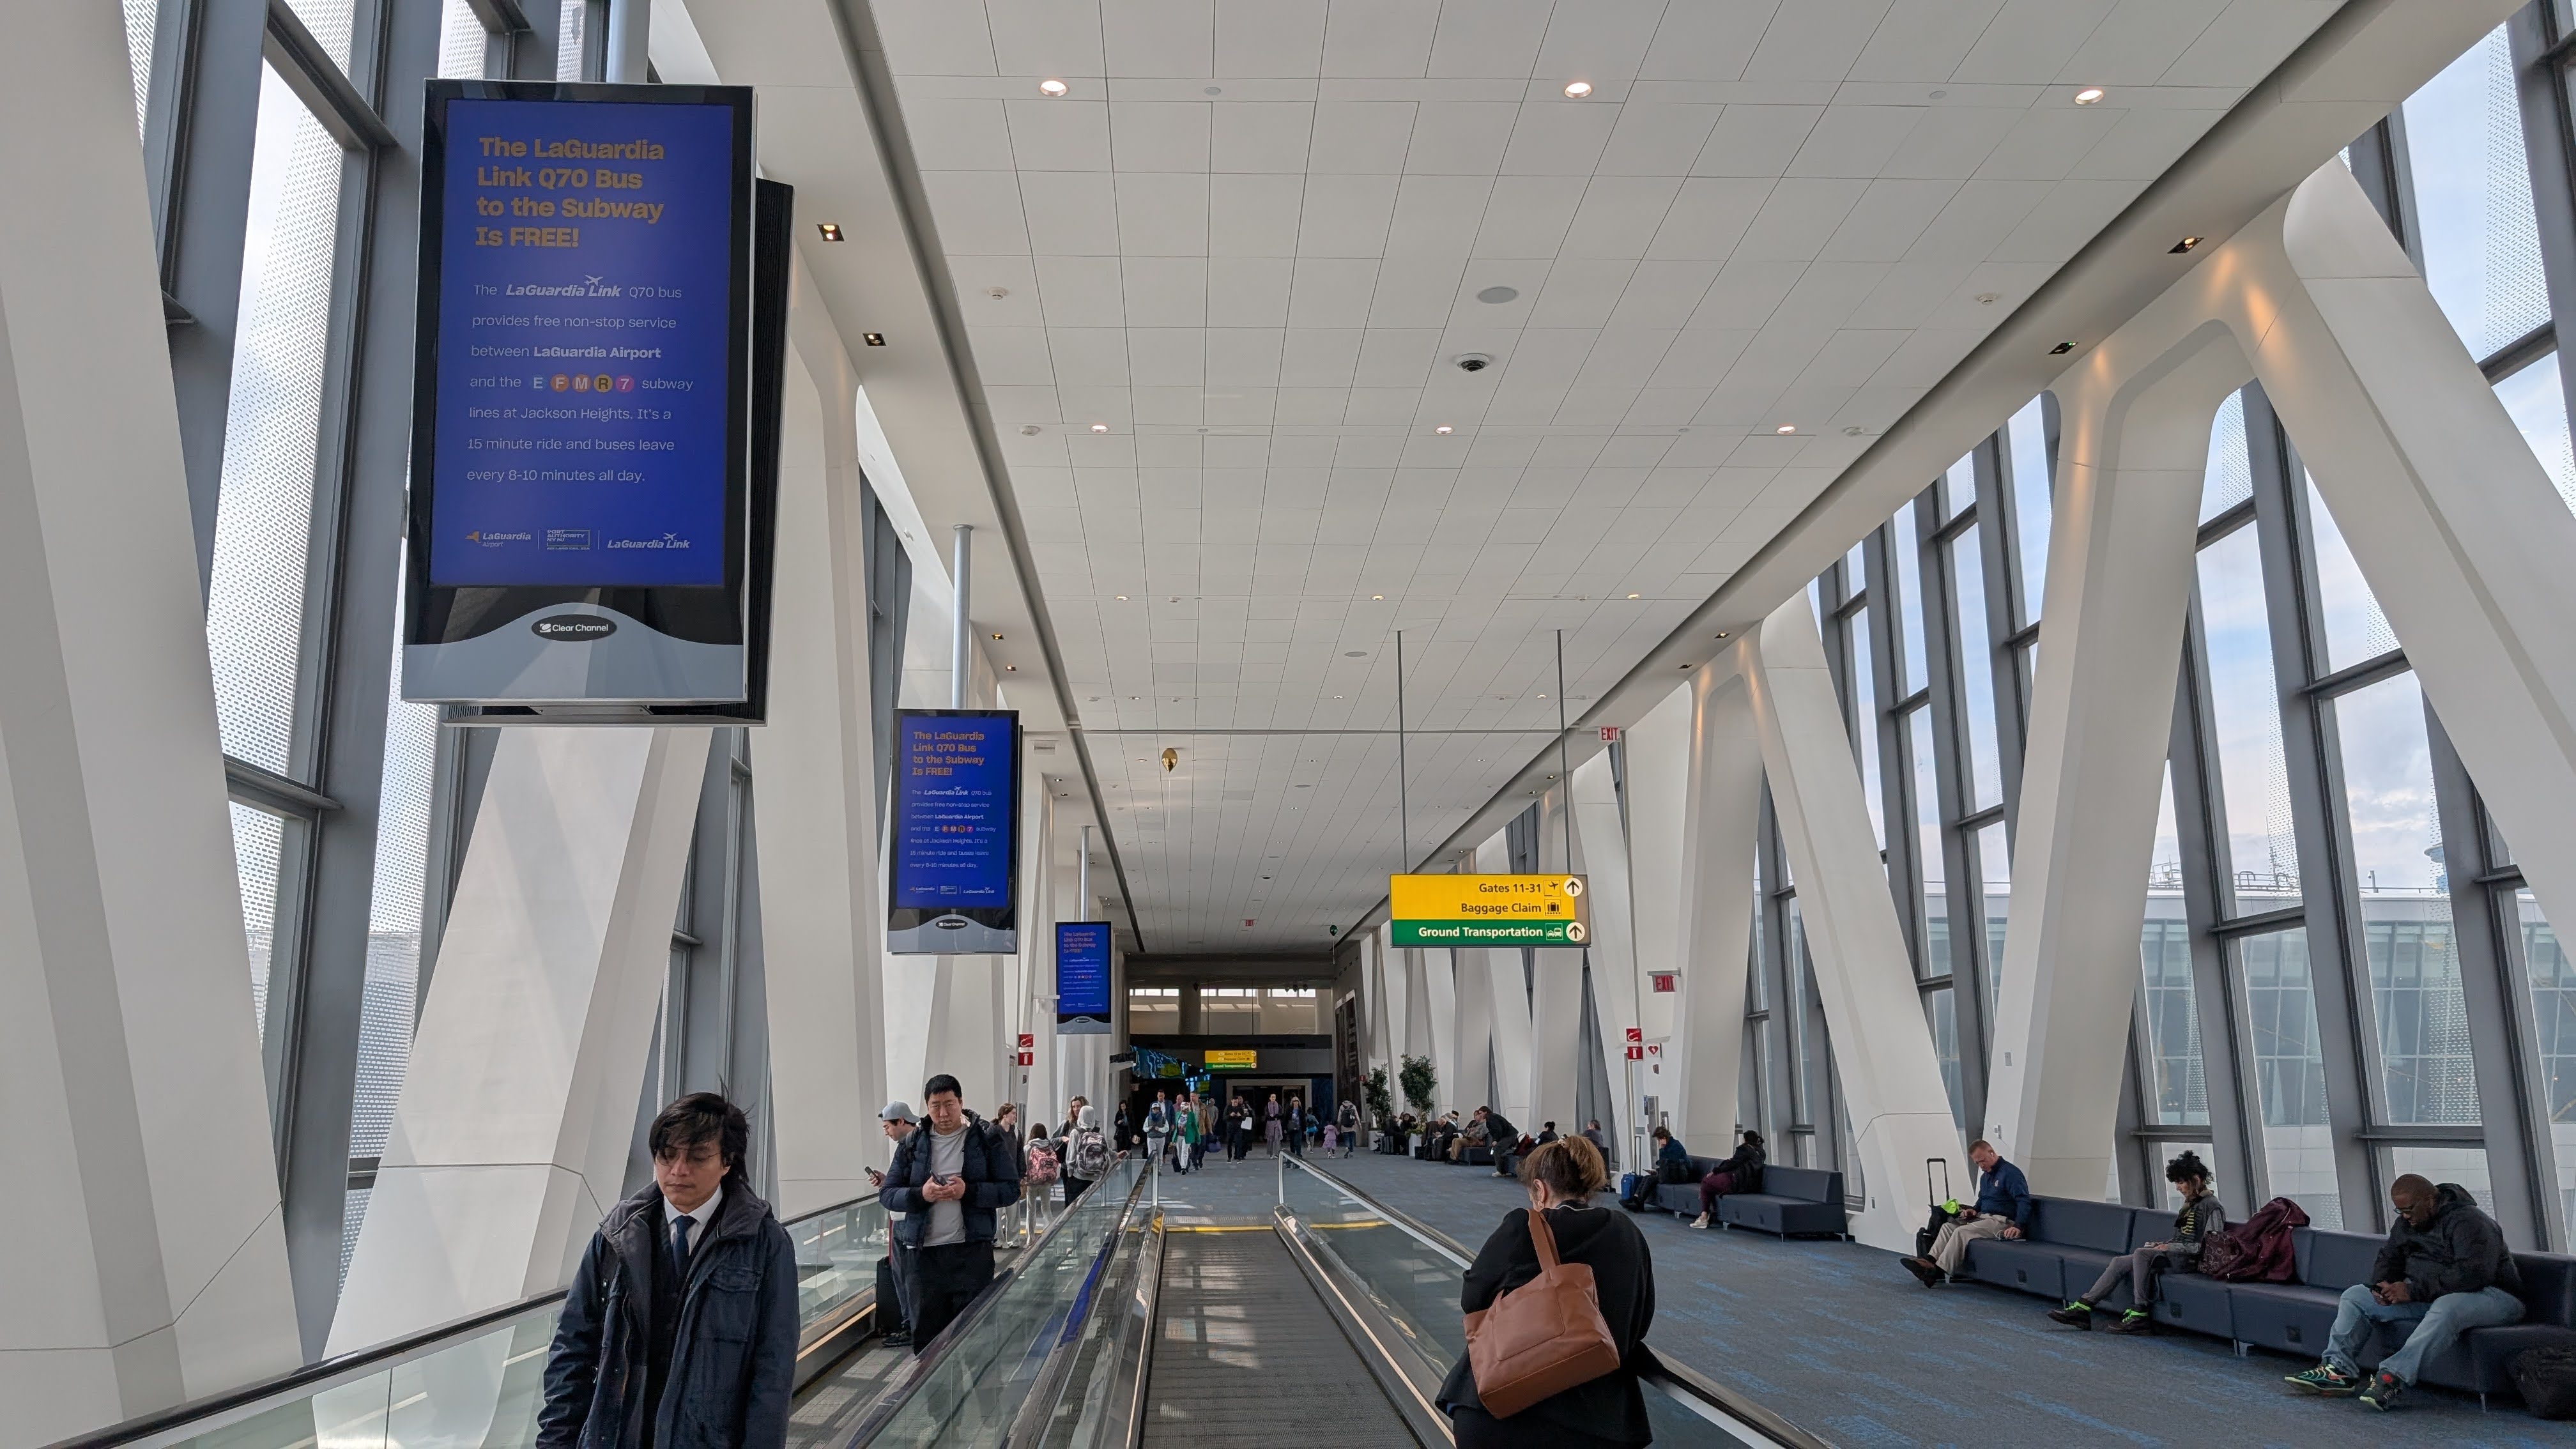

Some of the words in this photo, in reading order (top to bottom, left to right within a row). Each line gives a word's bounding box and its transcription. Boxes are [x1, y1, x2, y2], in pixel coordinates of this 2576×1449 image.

[480, 137, 526, 158] The
[534, 137, 664, 160] LaGuardia
[478, 166, 532, 187] Link
[539, 169, 588, 189] Q70
[595, 169, 642, 188] Bus
[476, 197, 504, 216] to
[511, 197, 555, 217] the
[562, 199, 664, 224] Subway
[475, 227, 503, 246] Is
[510, 227, 580, 247] FREE!
[473, 284, 497, 296] The
[506, 284, 584, 297] LaGuardia
[588, 284, 620, 298] Link
[629, 287, 654, 298] Q70
[658, 287, 682, 298] bus
[472, 314, 530, 328] provides
[533, 315, 560, 328] free
[564, 316, 624, 329] non-stop
[629, 317, 677, 328] service
[471, 345, 529, 358] between
[533, 346, 606, 358] LaGuardia
[610, 346, 661, 361] Airport
[470, 377, 496, 388] and
[499, 377, 521, 388] the
[533, 378, 543, 388] E
[555, 378, 565, 388] F
[576, 378, 588, 389] M
[598, 378, 608, 389] R
[620, 378, 629, 390] 7
[641, 378, 693, 392] subway
[469, 407, 500, 418] lines
[503, 408, 517, 418] at
[521, 408, 576, 419] Jackson
[581, 408, 633, 422] Heights.
[663, 411, 671, 420] a
[468, 438, 482, 449] 15
[486, 438, 533, 450] minute
[537, 438, 562, 450] ride
[566, 439, 592, 450] and
[595, 439, 635, 450] buses
[640, 440, 675, 450] leave
[466, 470, 504, 483] every
[509, 470, 537, 481] 8-10
[541, 470, 595, 481] minutes
[599, 470, 613, 481] all
[617, 470, 645, 484] day.
[608, 539, 663, 549] LaGuardia
[666, 539, 689, 549] Link
[552, 623, 574, 632] Clear
[576, 623, 608, 632] Channel
[913, 732, 931, 740] The
[935, 732, 985, 740] LaGuardia
[1601, 728, 1618, 740] EXIT
[913, 743, 934, 751] Link
[937, 744, 955, 753] Q70
[913, 755, 923, 763] to
[926, 755, 942, 763] the
[946, 756, 985, 766] Subway
[926, 767, 952, 776] FREE!
[1479, 884, 1510, 893] Gates
[1513, 884, 1542, 893] 11-31
[1461, 903, 1508, 915] Baggage
[1512, 903, 1542, 912] Claim
[1418, 927, 1460, 937] Ground
[1462, 927, 1543, 939] Transportation
[1656, 976, 1675, 992] EXIT
